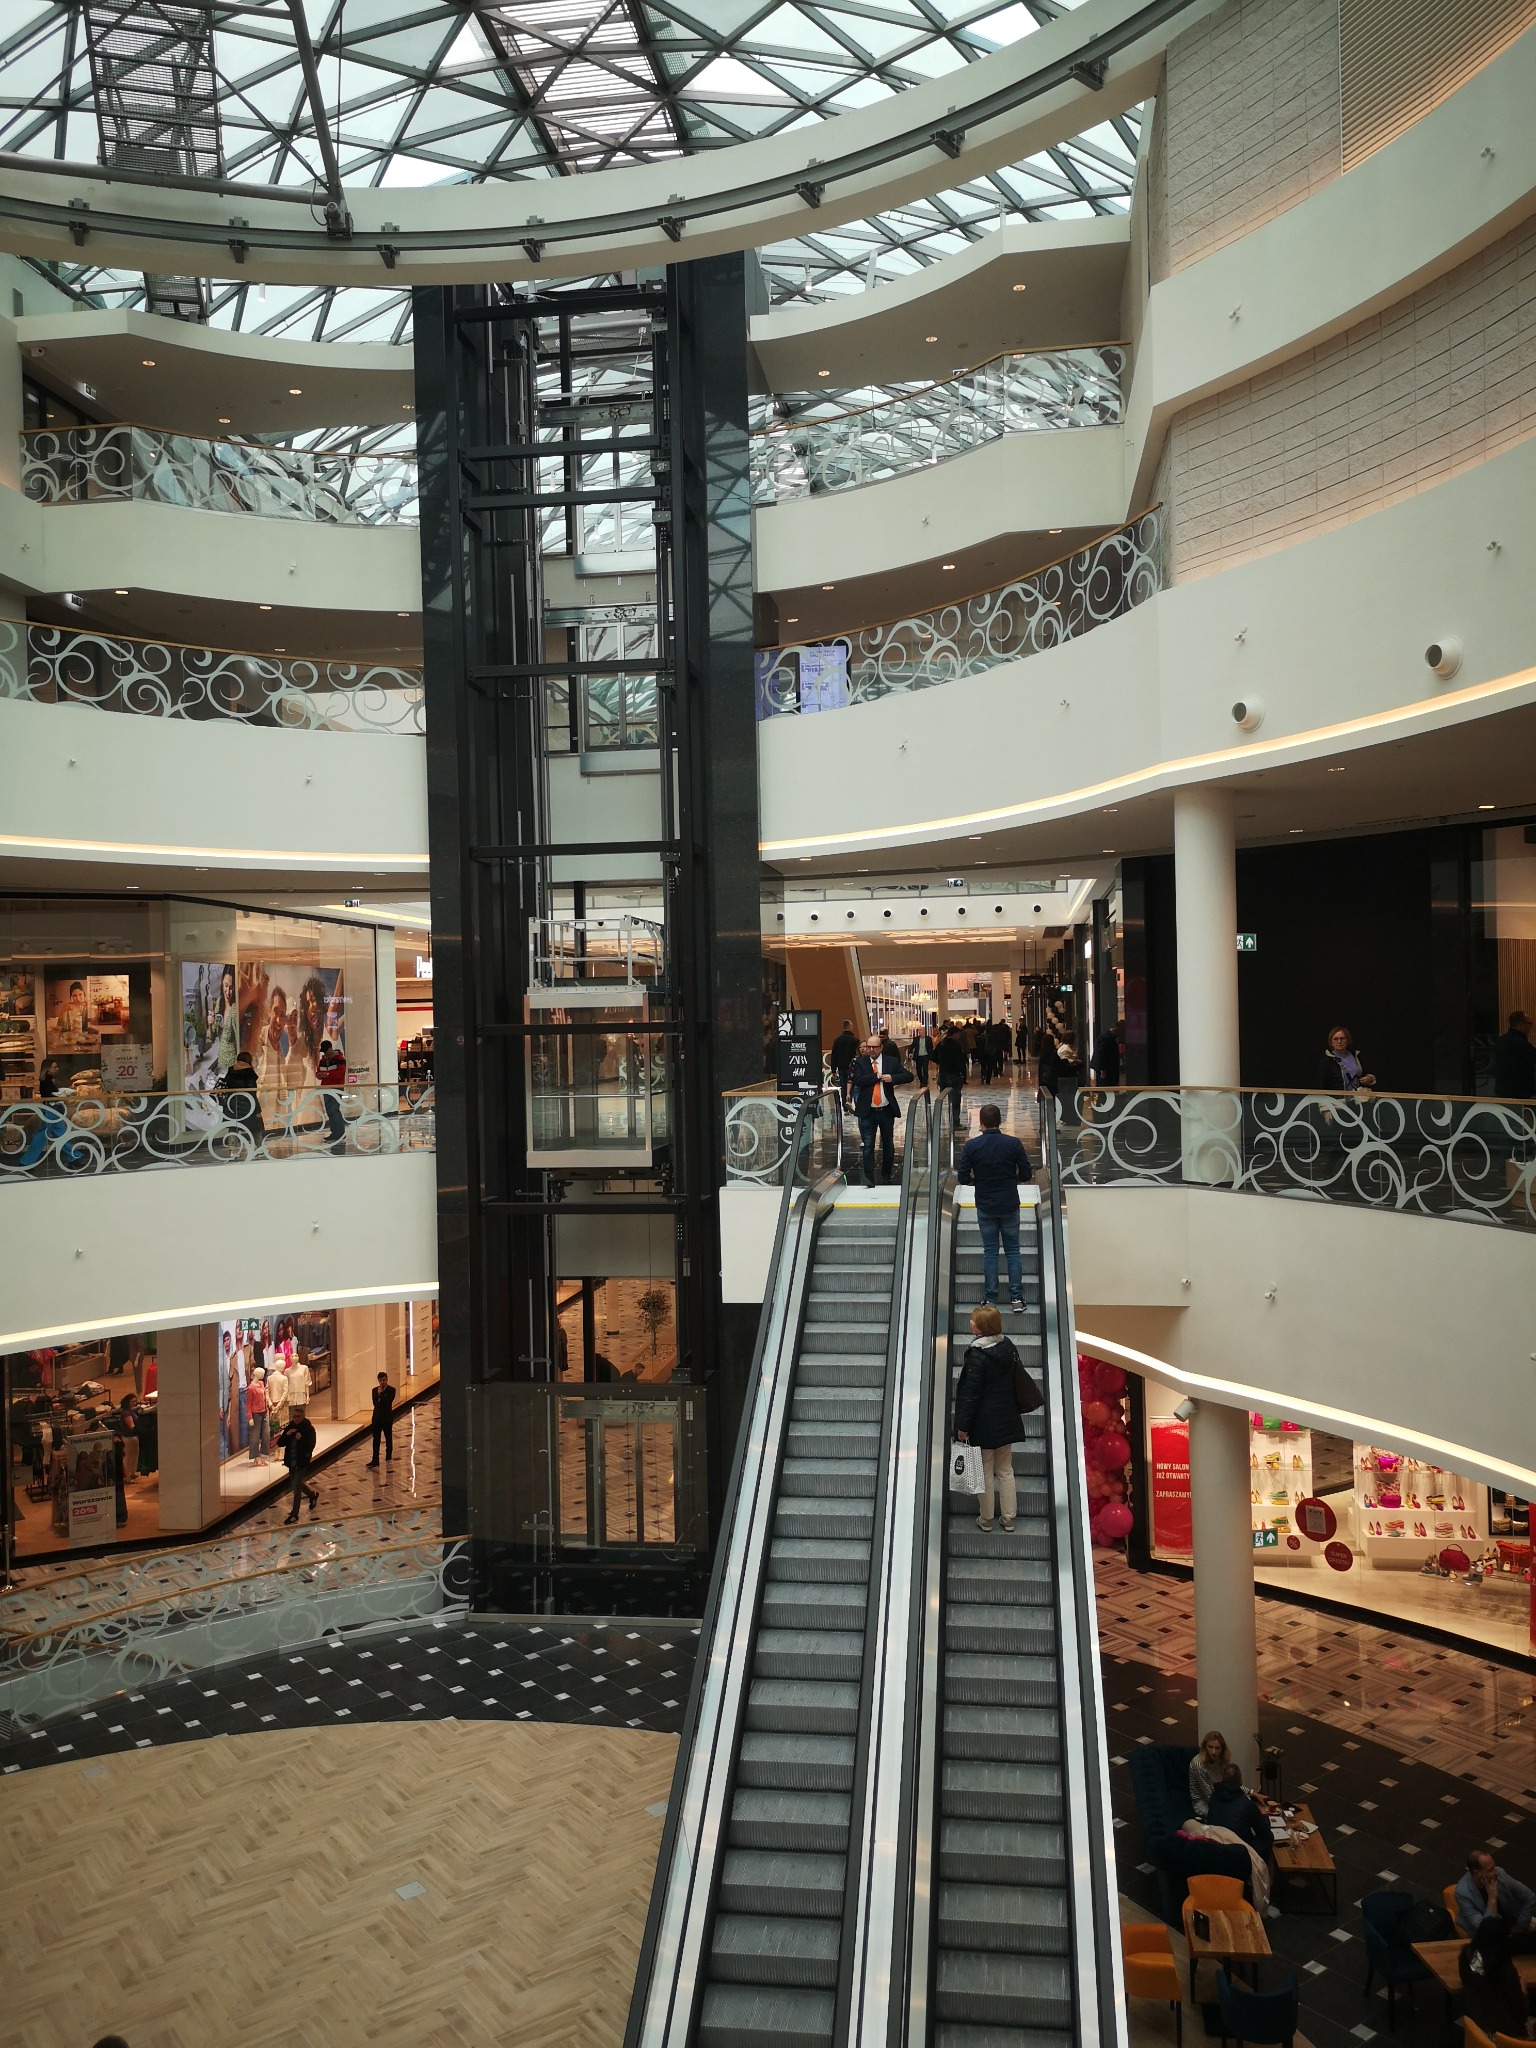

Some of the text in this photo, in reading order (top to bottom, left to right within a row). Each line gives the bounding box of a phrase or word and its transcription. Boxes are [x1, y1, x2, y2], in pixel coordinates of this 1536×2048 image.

[804, 1017, 808, 1030] 1
[789, 1055, 808, 1065] ZARA
[1156, 1471, 1165, 1479] JUŻ
[74, 1506, 96, 1516] 20%
